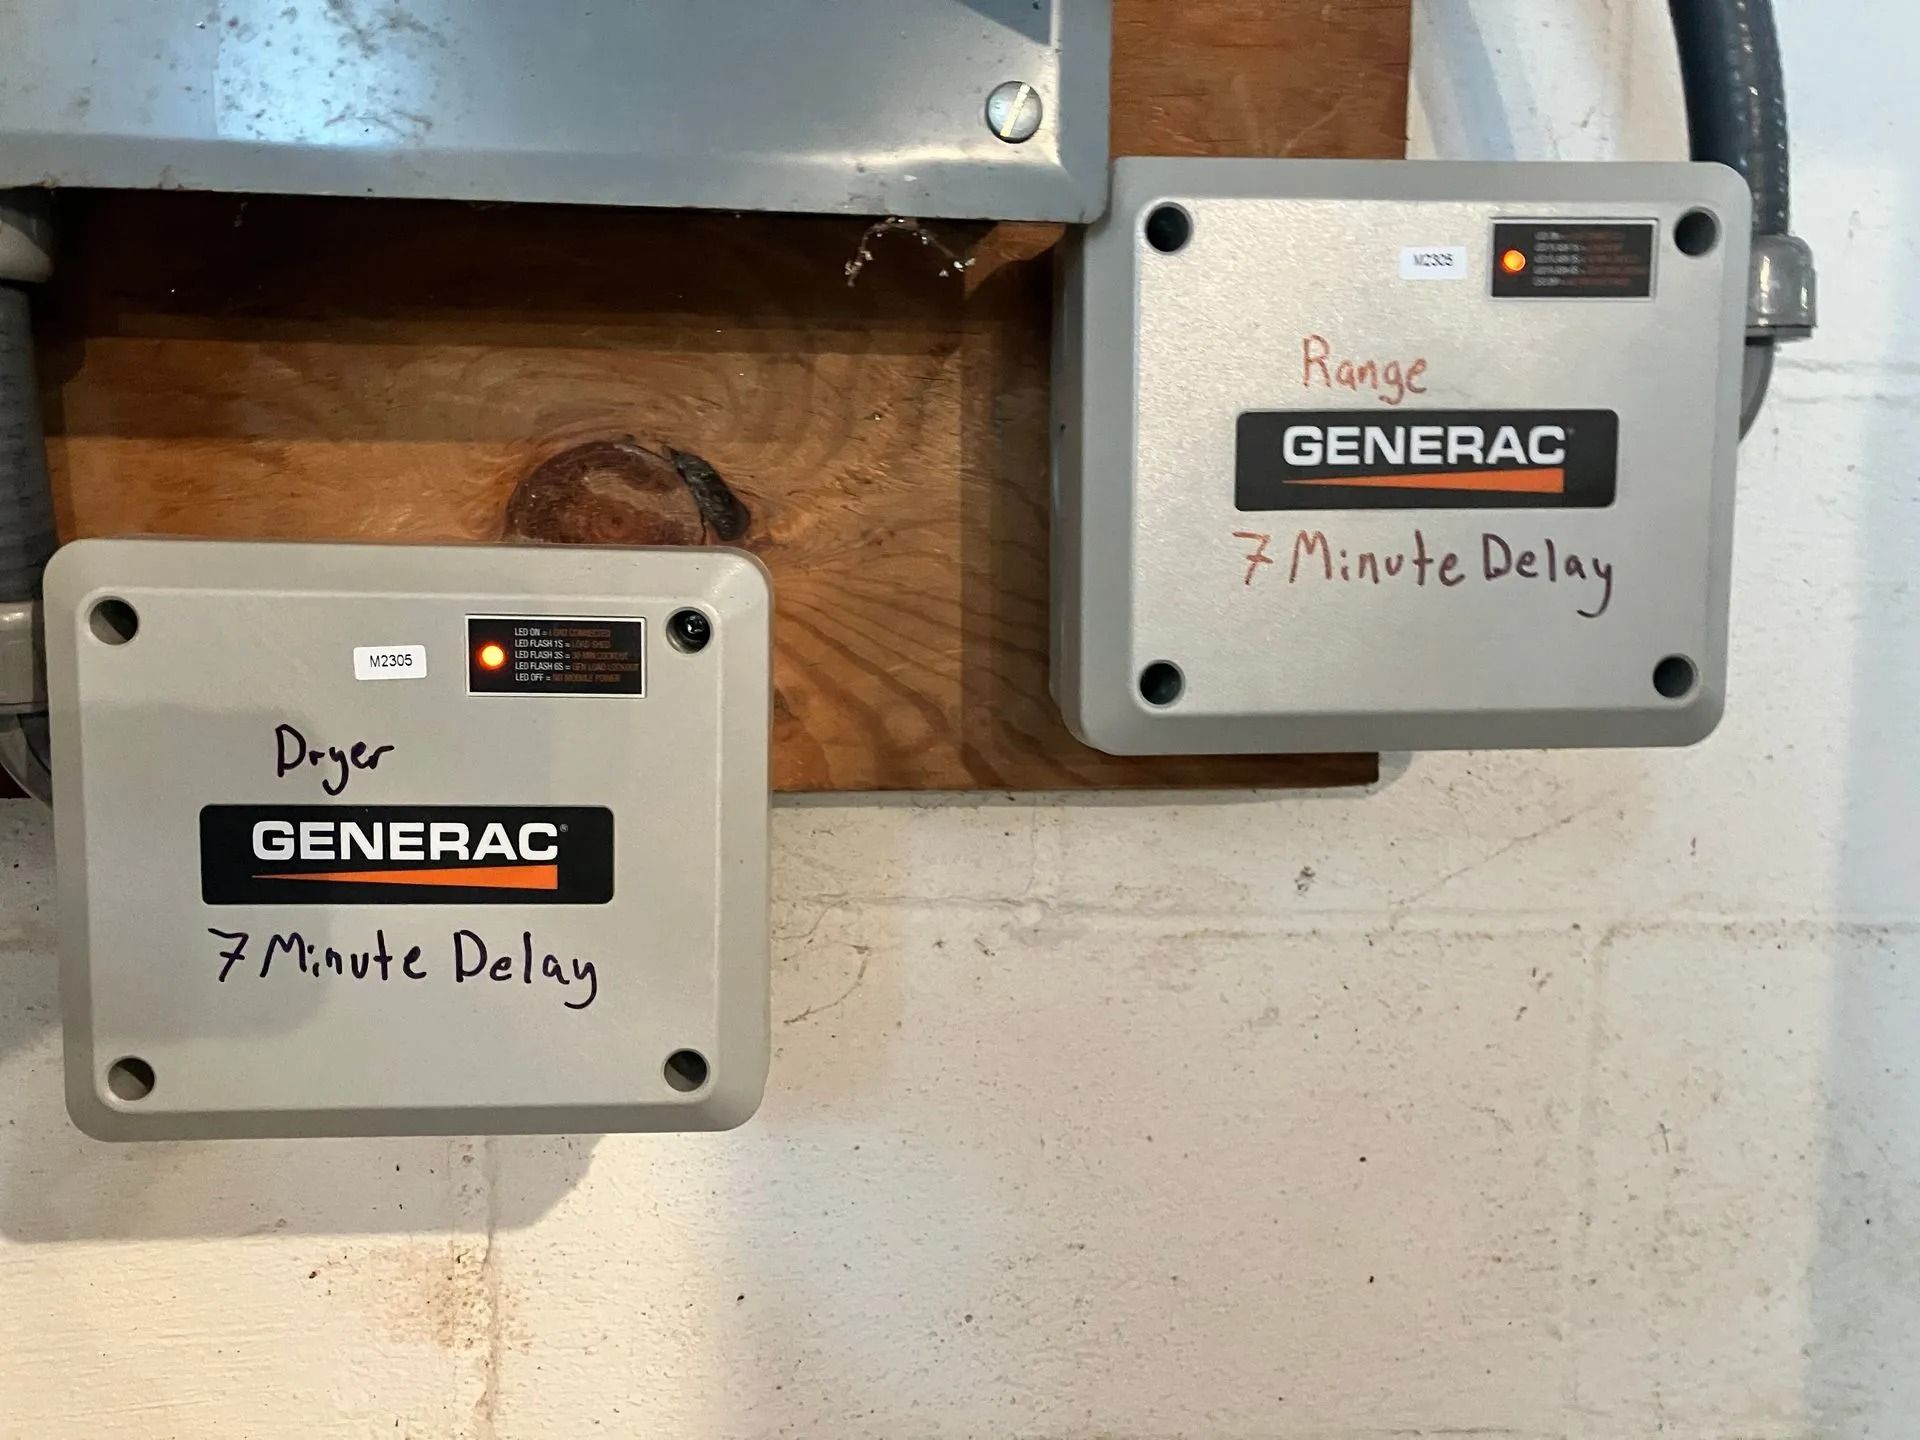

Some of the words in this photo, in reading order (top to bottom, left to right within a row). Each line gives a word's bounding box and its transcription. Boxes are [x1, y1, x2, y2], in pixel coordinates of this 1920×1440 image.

[1301, 334, 1428, 405] Range
[1282, 425, 1566, 466] GENERAC
[1232, 531, 1273, 585] 7
[1289, 529, 1466, 587] Minute
[1482, 533, 1613, 618] Delay
[369, 654, 413, 668] M2305
[275, 724, 394, 795] Dryer
[252, 821, 558, 860] GENERAC
[208, 928, 248, 982] 7
[259, 929, 427, 981] Minute
[453, 929, 598, 1009] Delay
